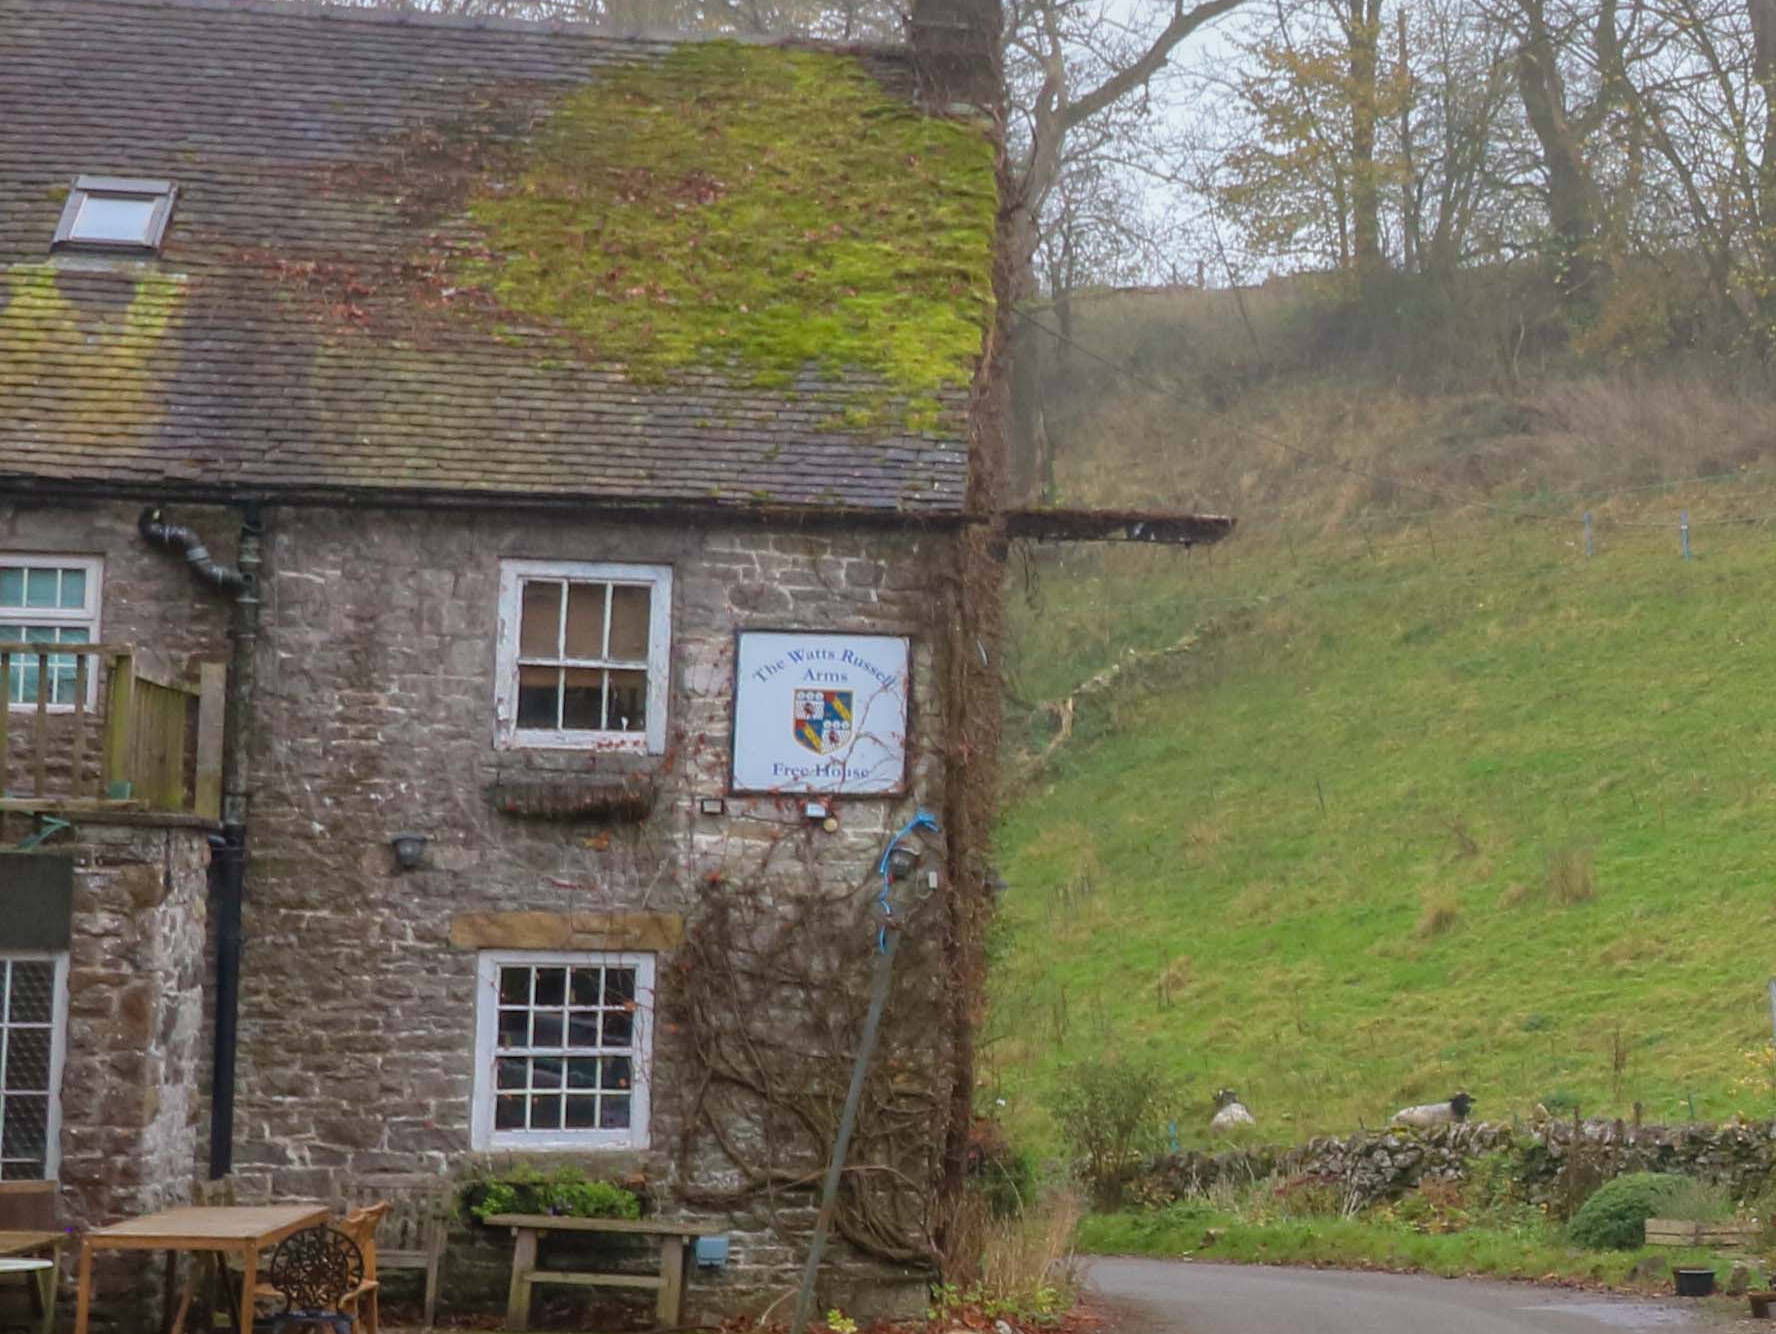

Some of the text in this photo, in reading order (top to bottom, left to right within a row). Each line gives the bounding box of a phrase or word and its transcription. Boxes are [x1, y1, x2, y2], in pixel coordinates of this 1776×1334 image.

[753, 648, 897, 688] The Watts Russell
[803, 668, 849, 682] Arms
[772, 763, 870, 778] Free House
